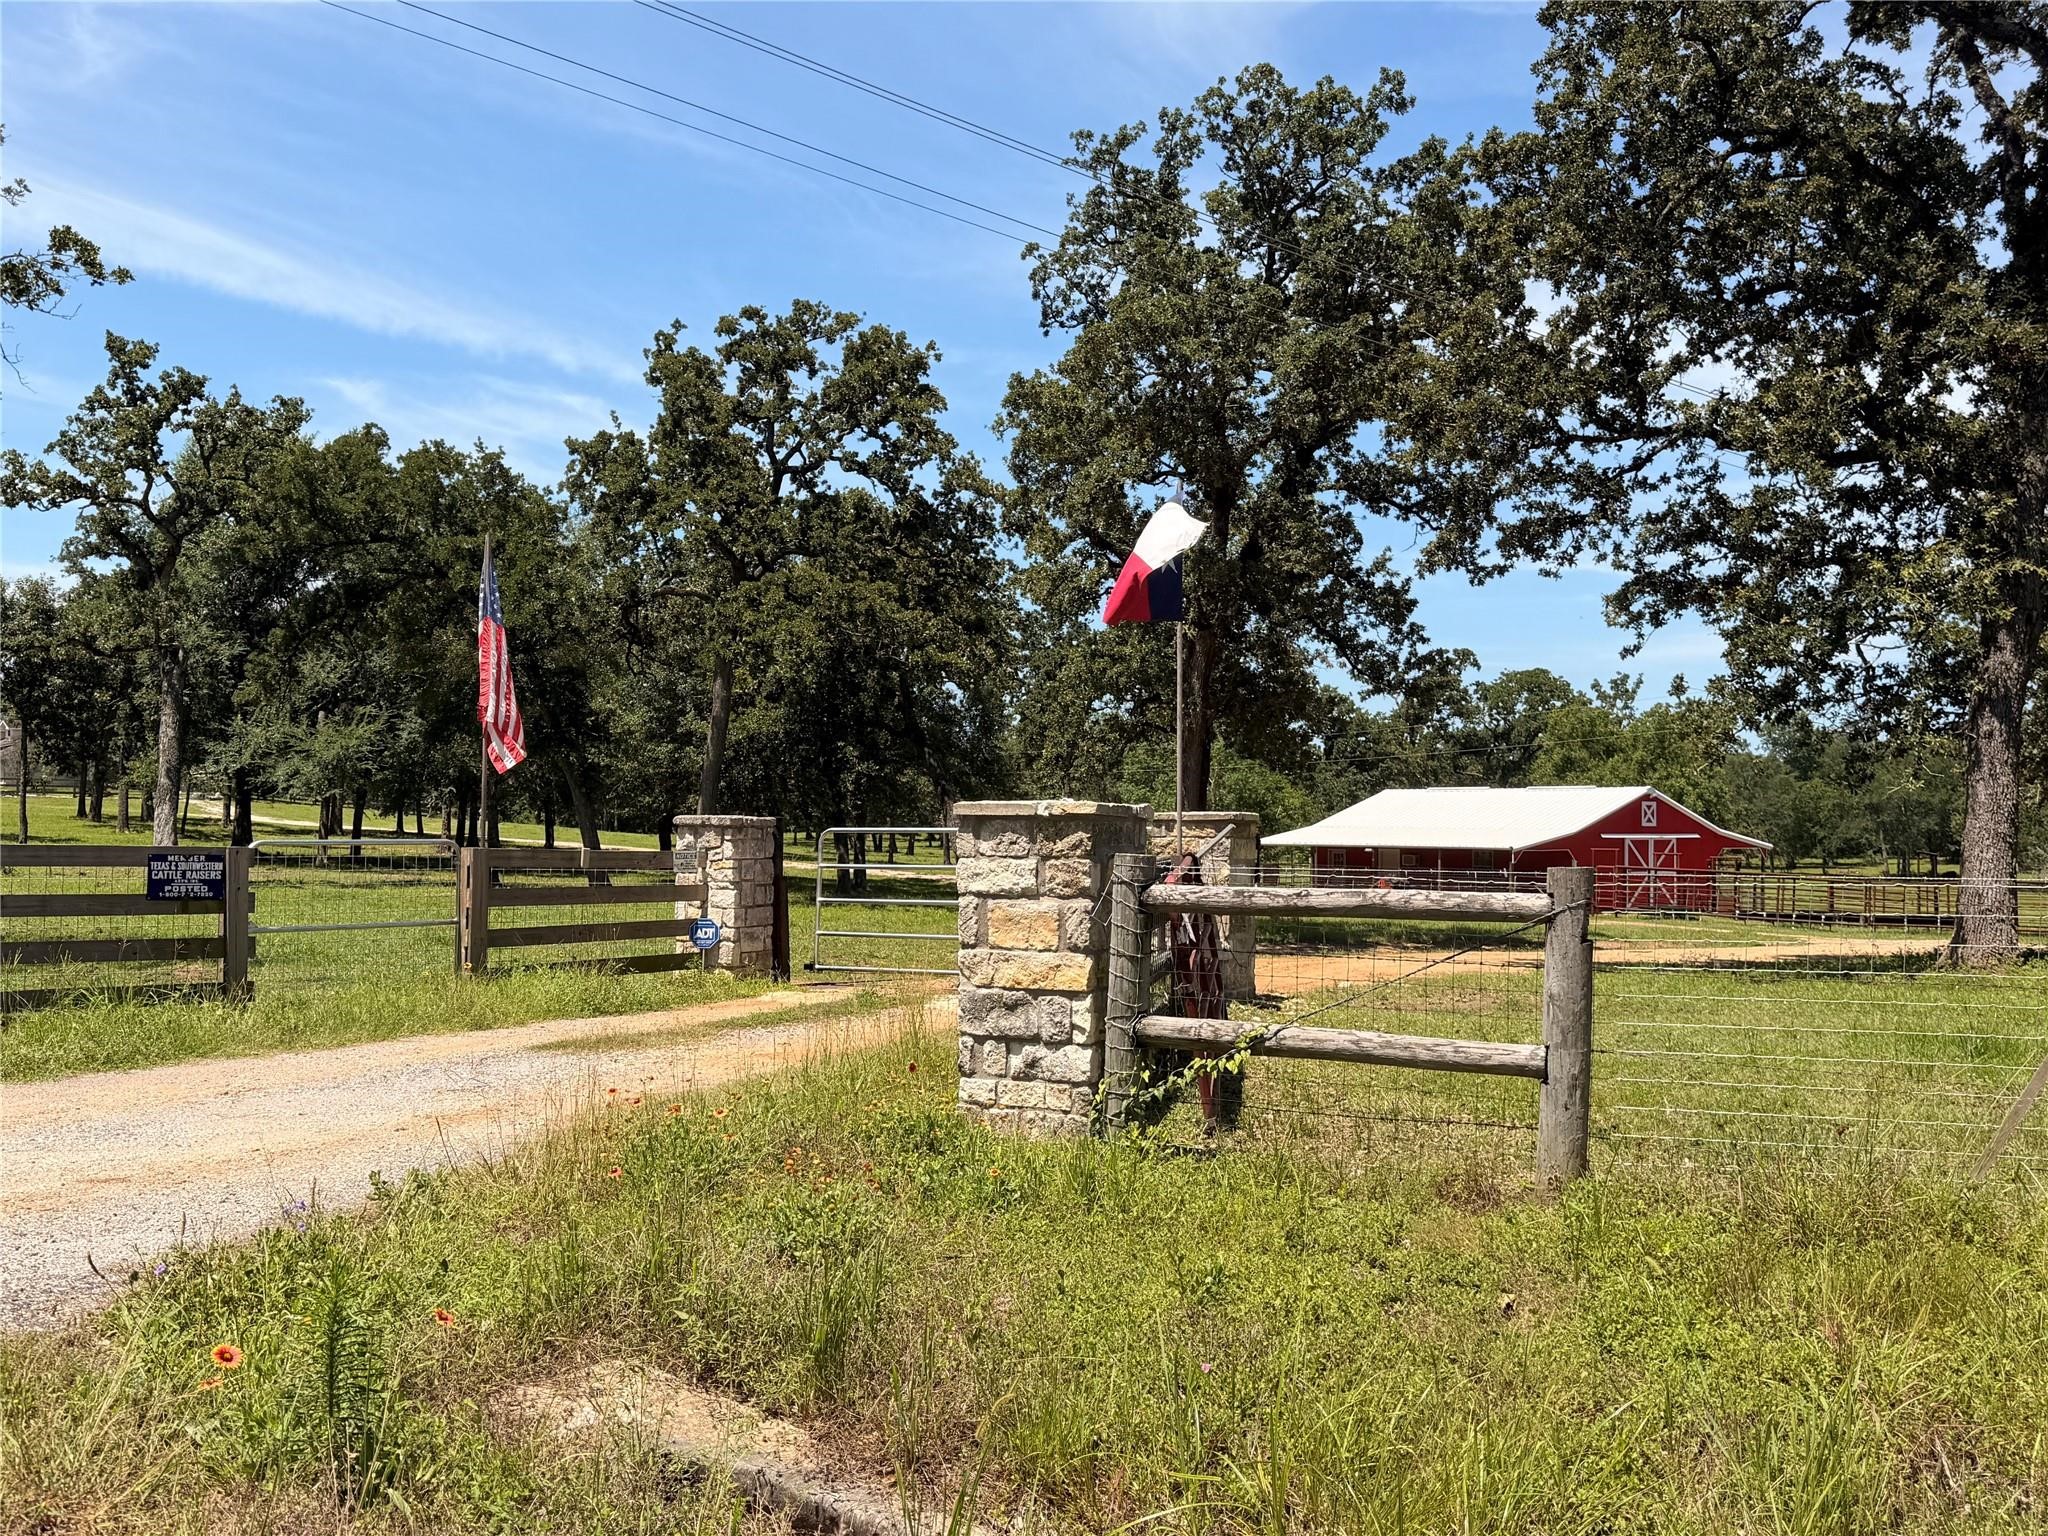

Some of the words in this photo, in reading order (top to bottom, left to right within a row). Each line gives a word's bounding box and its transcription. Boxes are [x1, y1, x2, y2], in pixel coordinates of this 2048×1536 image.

[150, 861, 170, 871] TEXAS
[171, 861, 176, 871] &
[177, 861, 223, 871] SOUTHWESTERN
[151, 870, 183, 879] CATTLE
[186, 870, 222, 879] RAISERS
[696, 927, 714, 939] ADT
